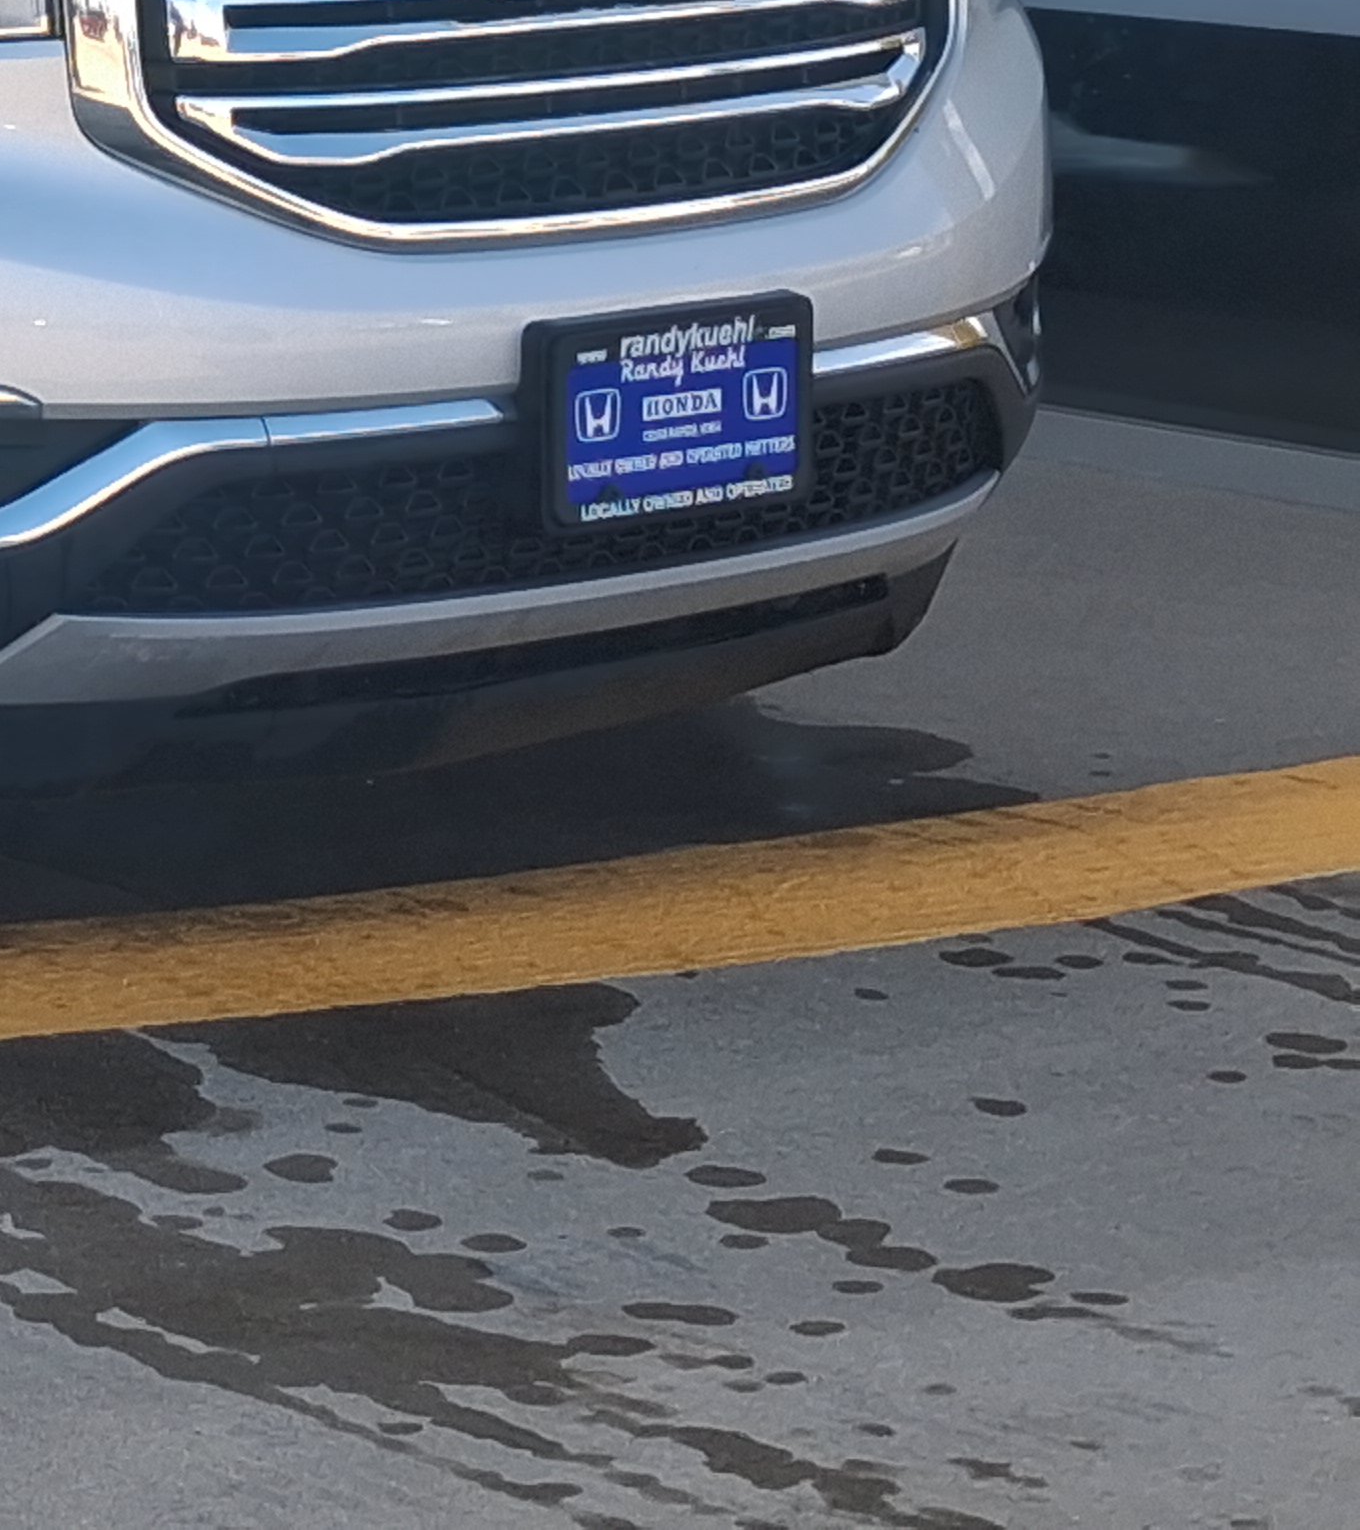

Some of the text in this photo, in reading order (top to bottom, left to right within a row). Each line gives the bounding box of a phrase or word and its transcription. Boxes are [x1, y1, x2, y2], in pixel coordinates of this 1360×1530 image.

[620, 314, 755, 359] randykuehl
[620, 354, 684, 387] Randy
[646, 391, 719, 418] HONDA
[581, 498, 641, 522] LOCALLY
